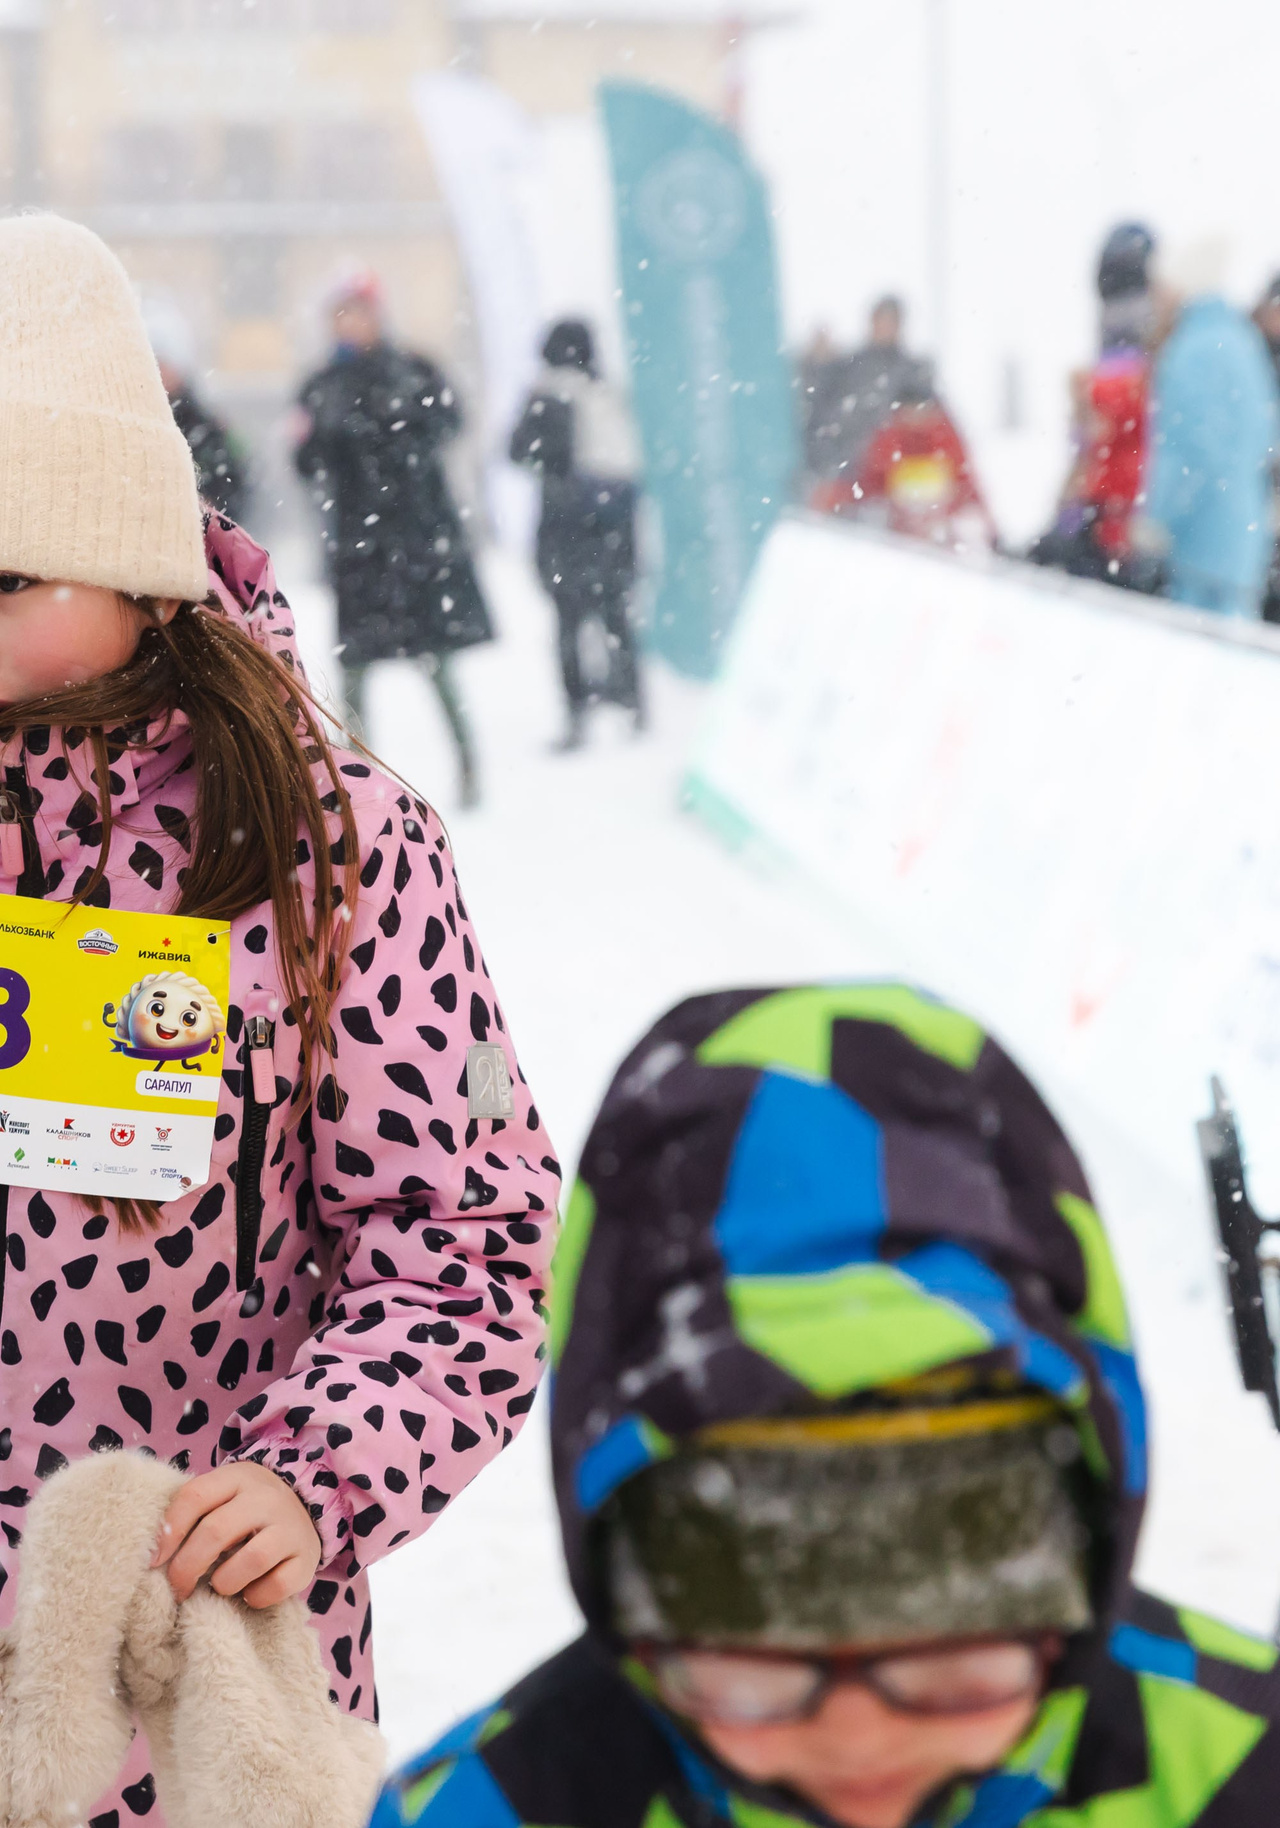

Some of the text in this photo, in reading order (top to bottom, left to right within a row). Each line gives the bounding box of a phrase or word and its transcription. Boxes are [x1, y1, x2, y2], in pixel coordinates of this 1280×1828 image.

[78, 940, 117, 952] ВОСТОЧНЫЙ
[138, 950, 191, 963] ижавиа
[144, 1078, 192, 1093] САРАПУЛ
[46, 1128, 91, 1138] КАЛАШНИКОВ
